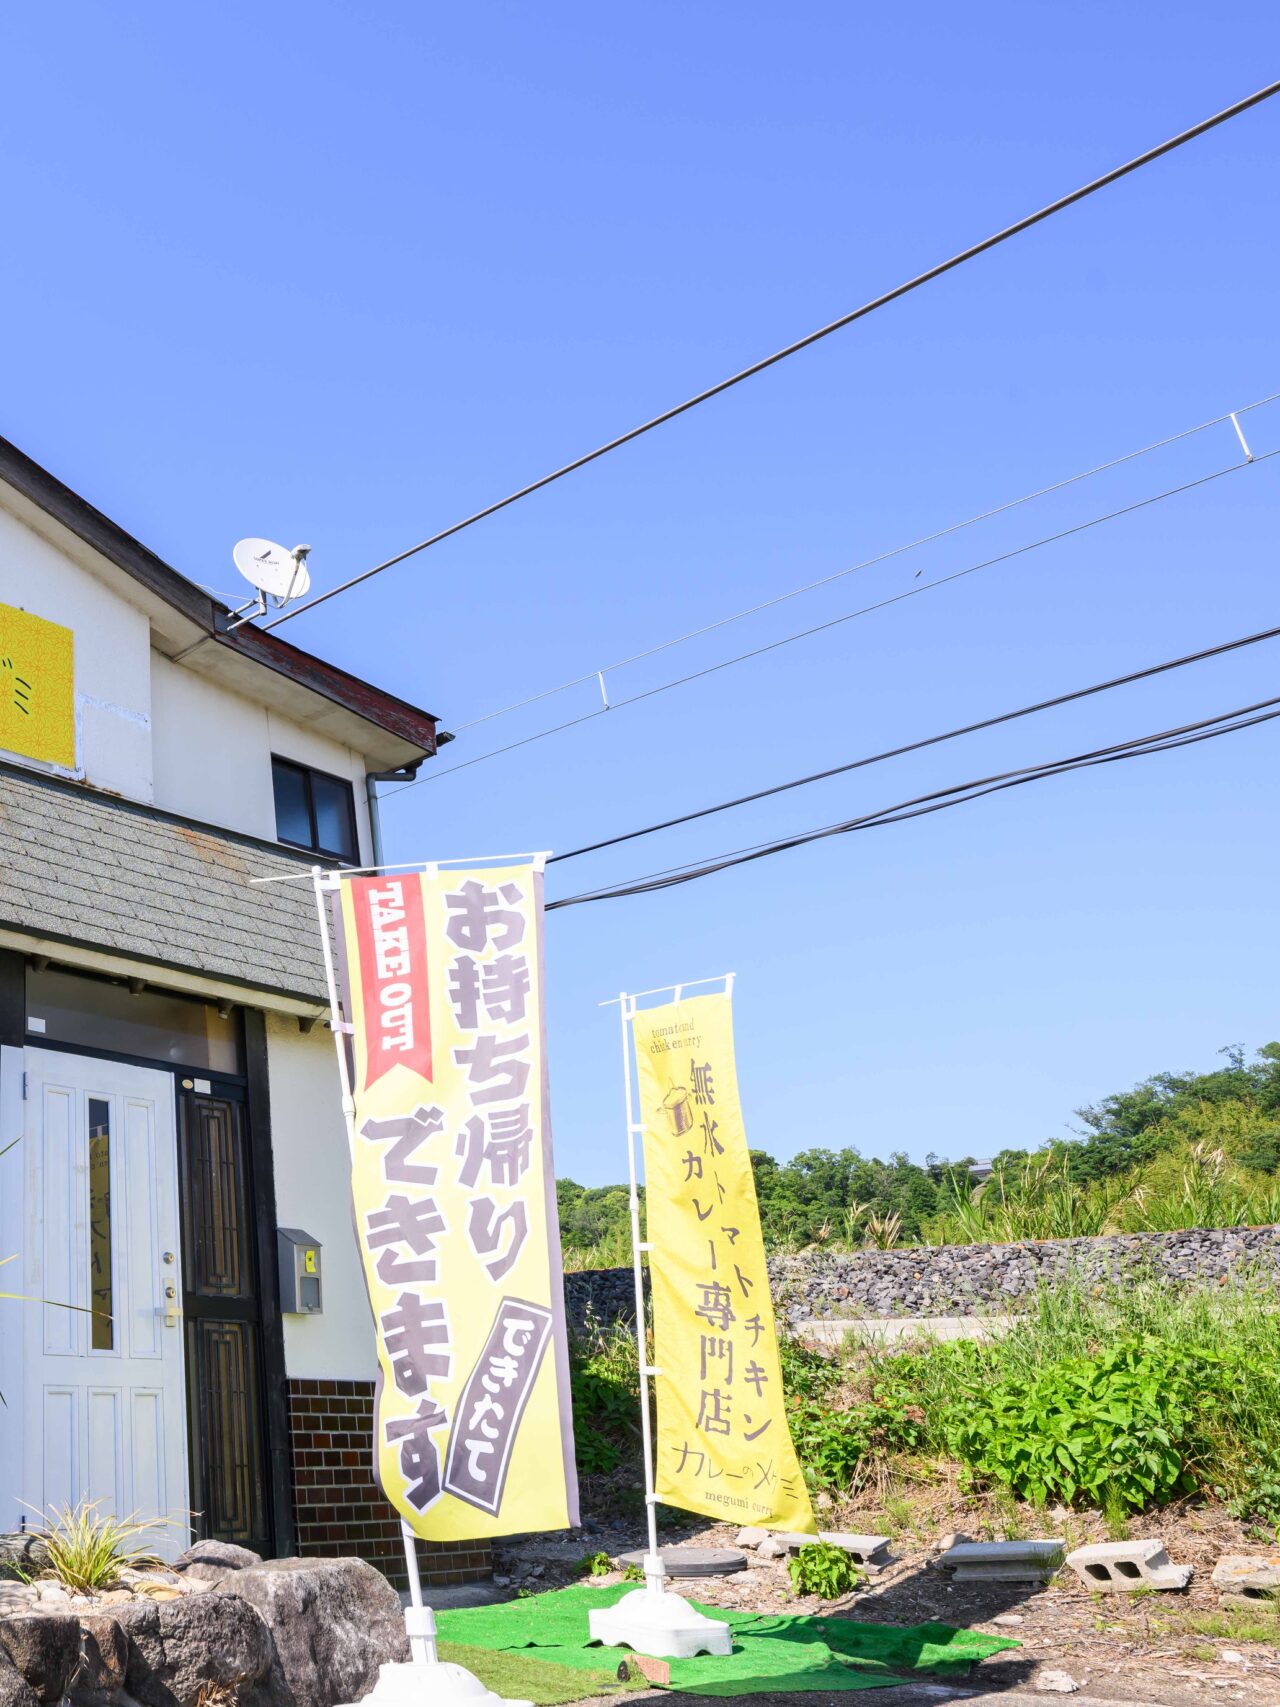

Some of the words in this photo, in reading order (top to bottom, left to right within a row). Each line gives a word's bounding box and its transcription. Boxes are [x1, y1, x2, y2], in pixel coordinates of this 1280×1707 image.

[368, 881, 411, 979] TAKE
[379, 982, 415, 1051] OUT
[444, 879, 535, 1283] お持ち帰り
[360, 1105, 451, 1514] できます
[689, 1058, 772, 1442] 無水トマトチキン
[464, 1317, 536, 1482] できたて
[705, 1491, 749, 1508] megumi
